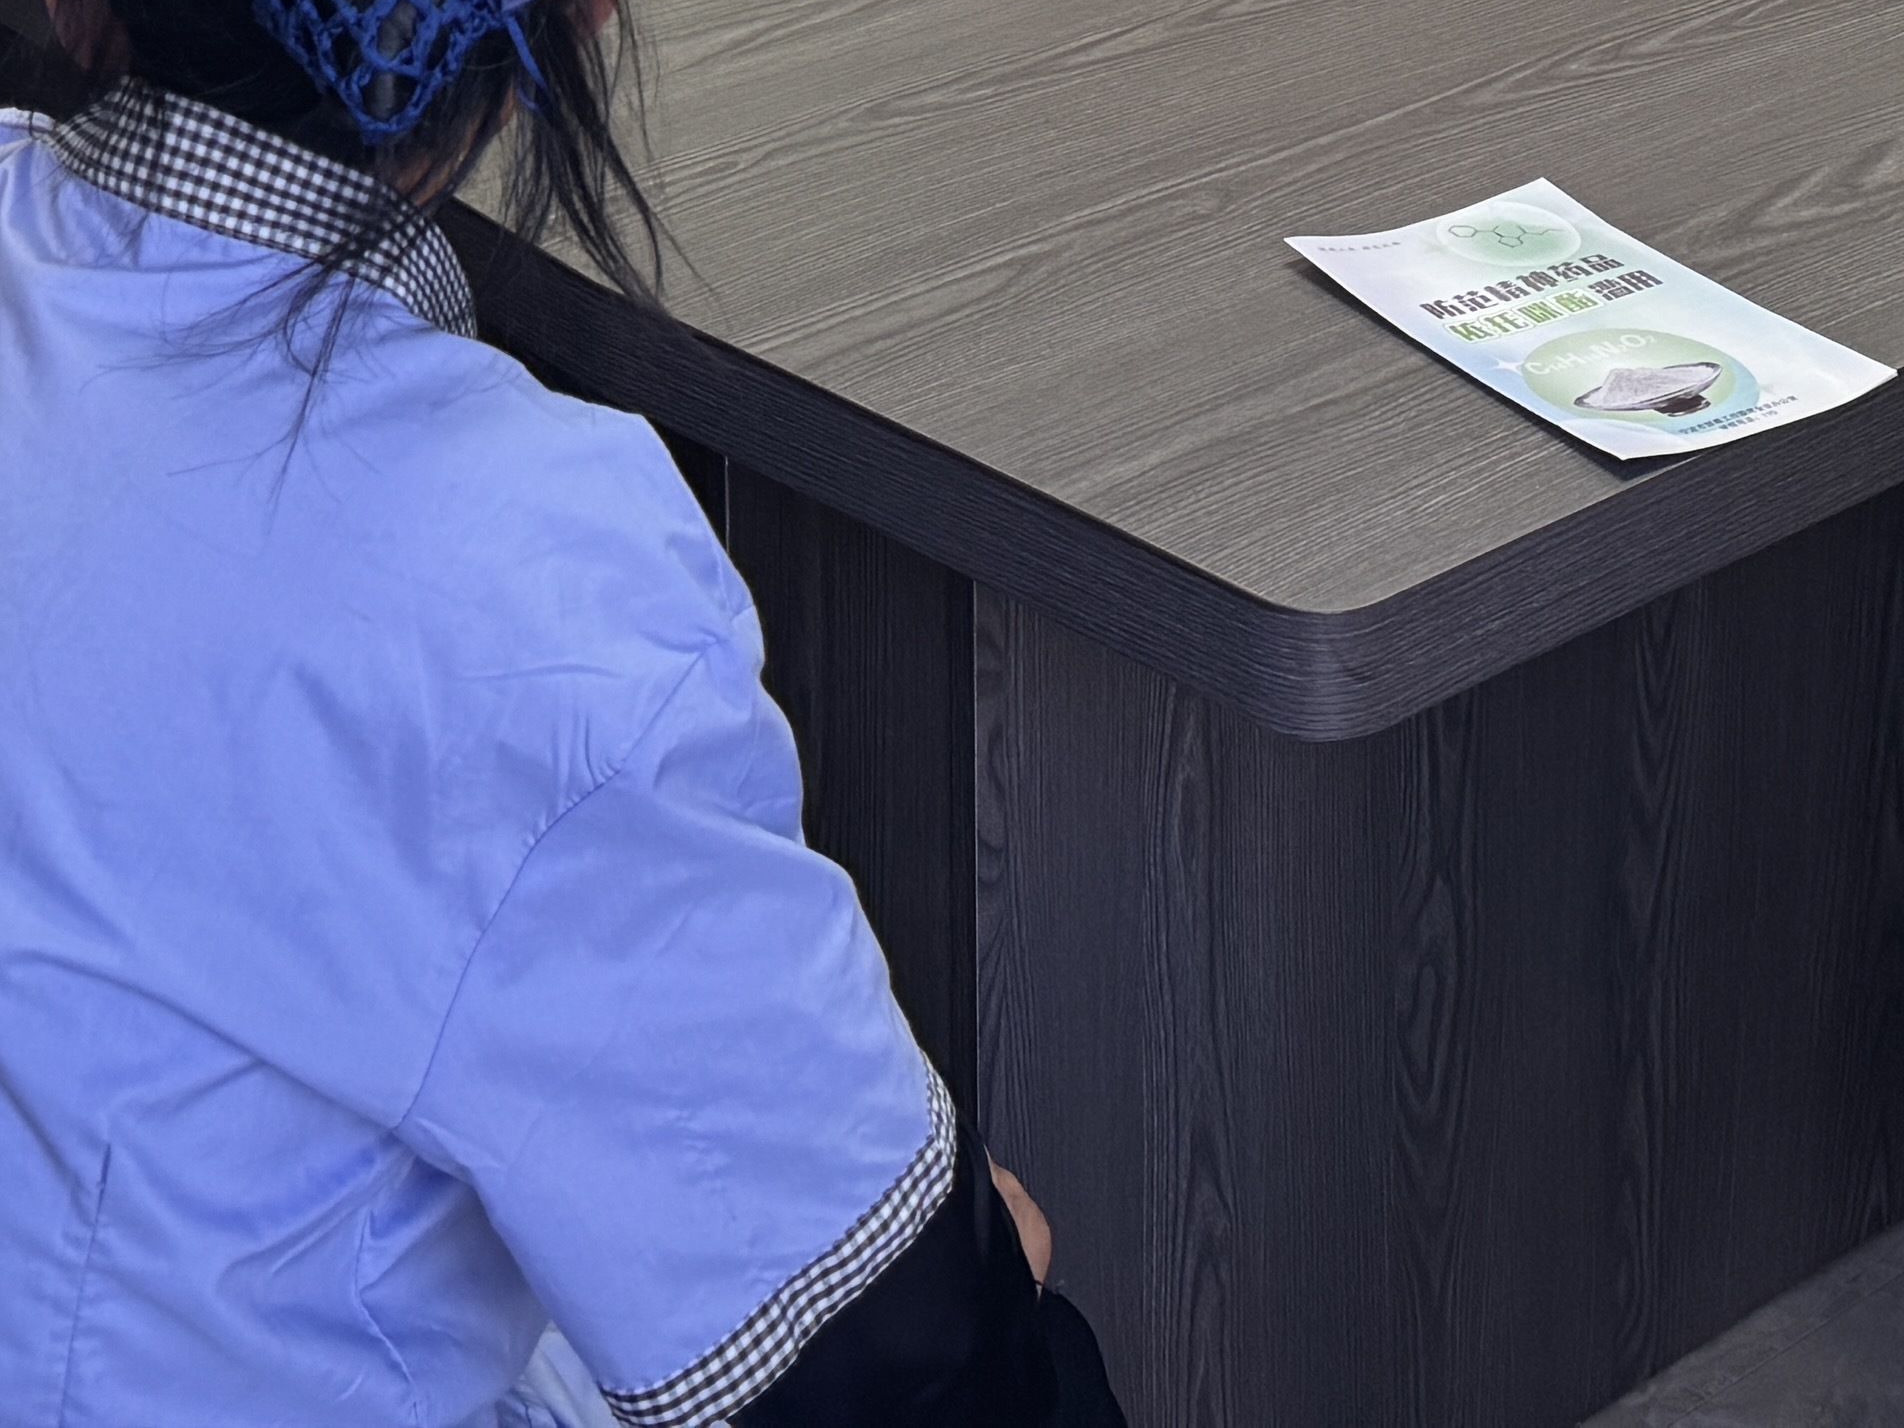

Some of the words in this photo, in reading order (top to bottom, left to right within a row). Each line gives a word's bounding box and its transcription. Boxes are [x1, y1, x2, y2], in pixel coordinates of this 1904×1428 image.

[1420, 253, 1625, 319] 防范精神药品
